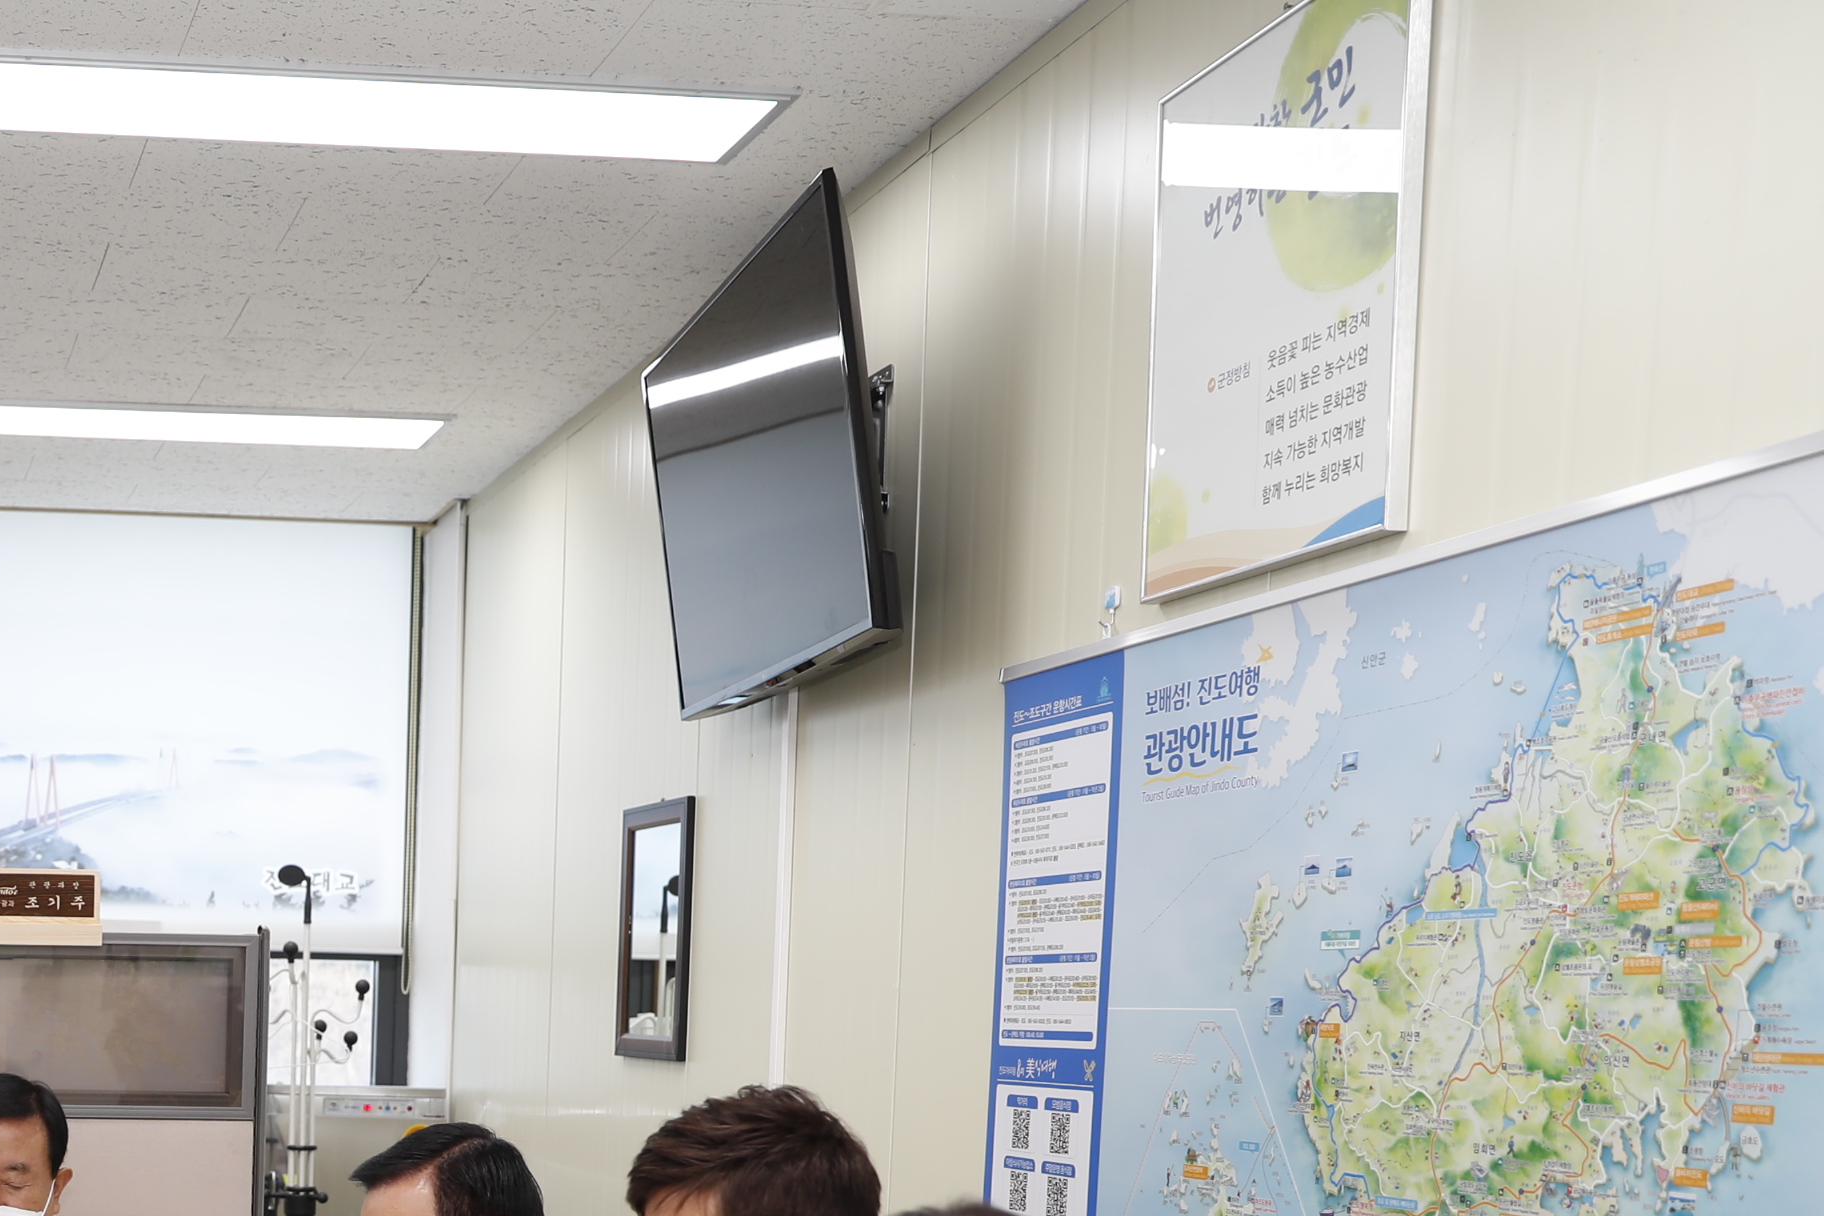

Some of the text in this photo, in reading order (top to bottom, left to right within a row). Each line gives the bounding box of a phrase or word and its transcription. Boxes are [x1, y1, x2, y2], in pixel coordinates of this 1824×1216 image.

[1267, 307, 1371, 370] 웃음꽃 피는 지역경제
[1217, 361, 1251, 390] 군정방침
[1265, 344, 1368, 403] 소득이 높은 농수산업
[1265, 380, 1368, 436] 매력 넘치는 문화관광
[1263, 416, 1366, 470] 지속 가능한 지역개발
[1262, 452, 1363, 506] 함께 누리는 희망복지
[1360, 651, 1387, 669] 신안군
[1145, 665, 1261, 716] 보배섬! 진도여행
[1053, 696, 1083, 715] 운항시간표
[1143, 713, 1259, 775] 관광안내도
[1639, 730, 1666, 746] 군내면
[1141, 775, 1259, 803] Tourist Guide Map of Jindo County
[1510, 851, 1533, 863] 진도읍
[29, 881, 80, 889] 관광과장
[265, 870, 355, 892] 진대교
[1697, 876, 1726, 891] 고군면
[24, 895, 85, 911] 조기주
[1399, 1031, 1421, 1043] 지산면
[1604, 1055, 1630, 1068] 의신면
[1473, 1142, 1495, 1155] 임회면
